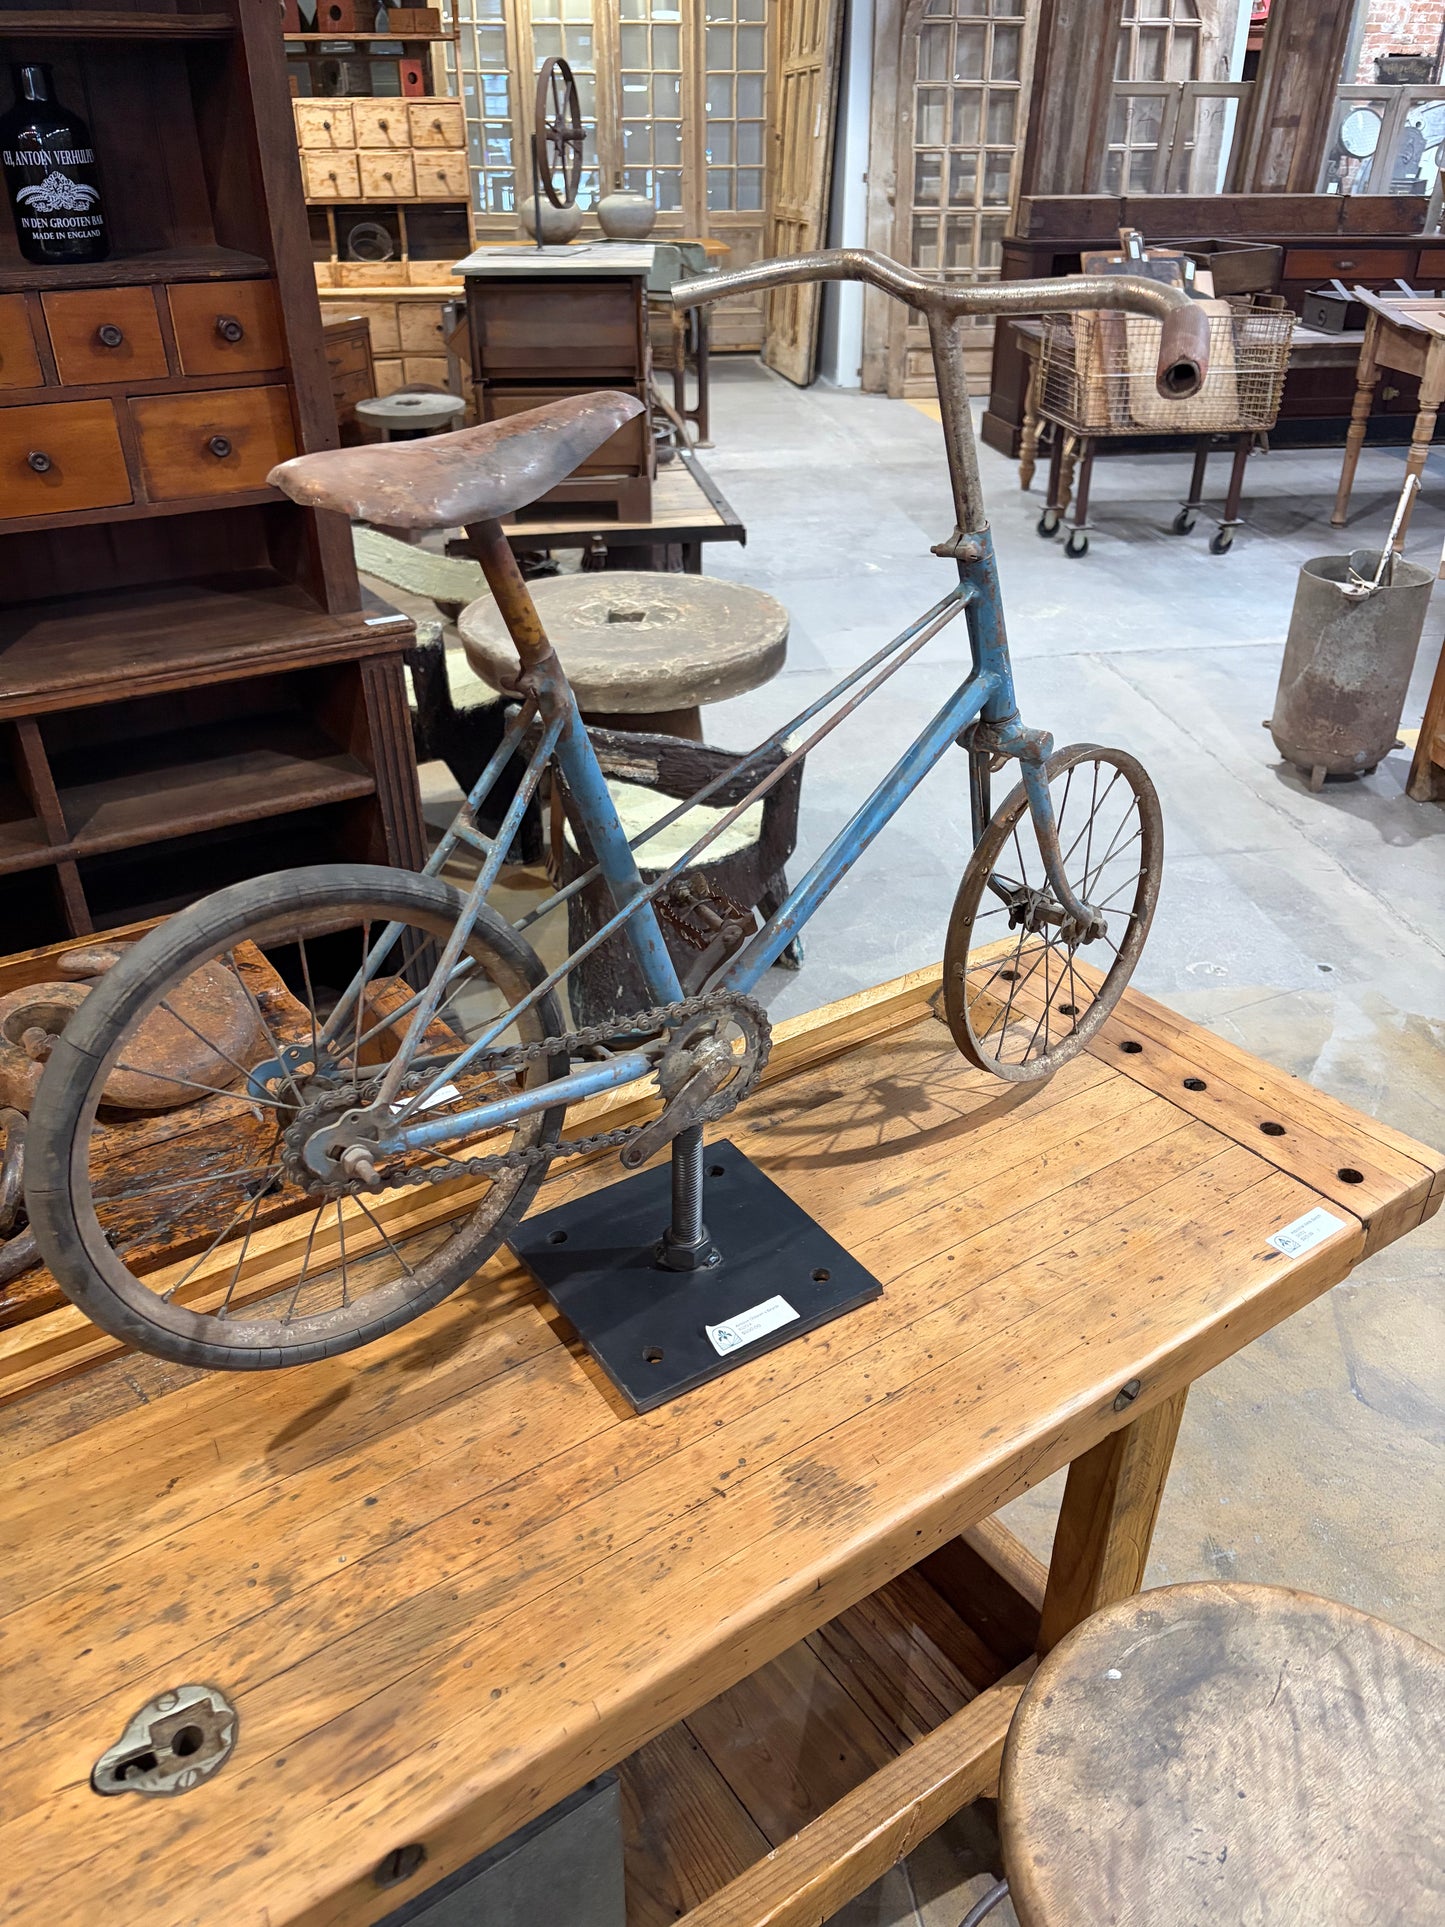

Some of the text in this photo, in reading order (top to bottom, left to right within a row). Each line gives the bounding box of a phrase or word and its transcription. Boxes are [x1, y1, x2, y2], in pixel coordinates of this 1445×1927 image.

[31, 217, 48, 229] DEN
[50, 216, 91, 228] GROOTEN
[32, 229, 101, 240] MADE IN ENGLAND
